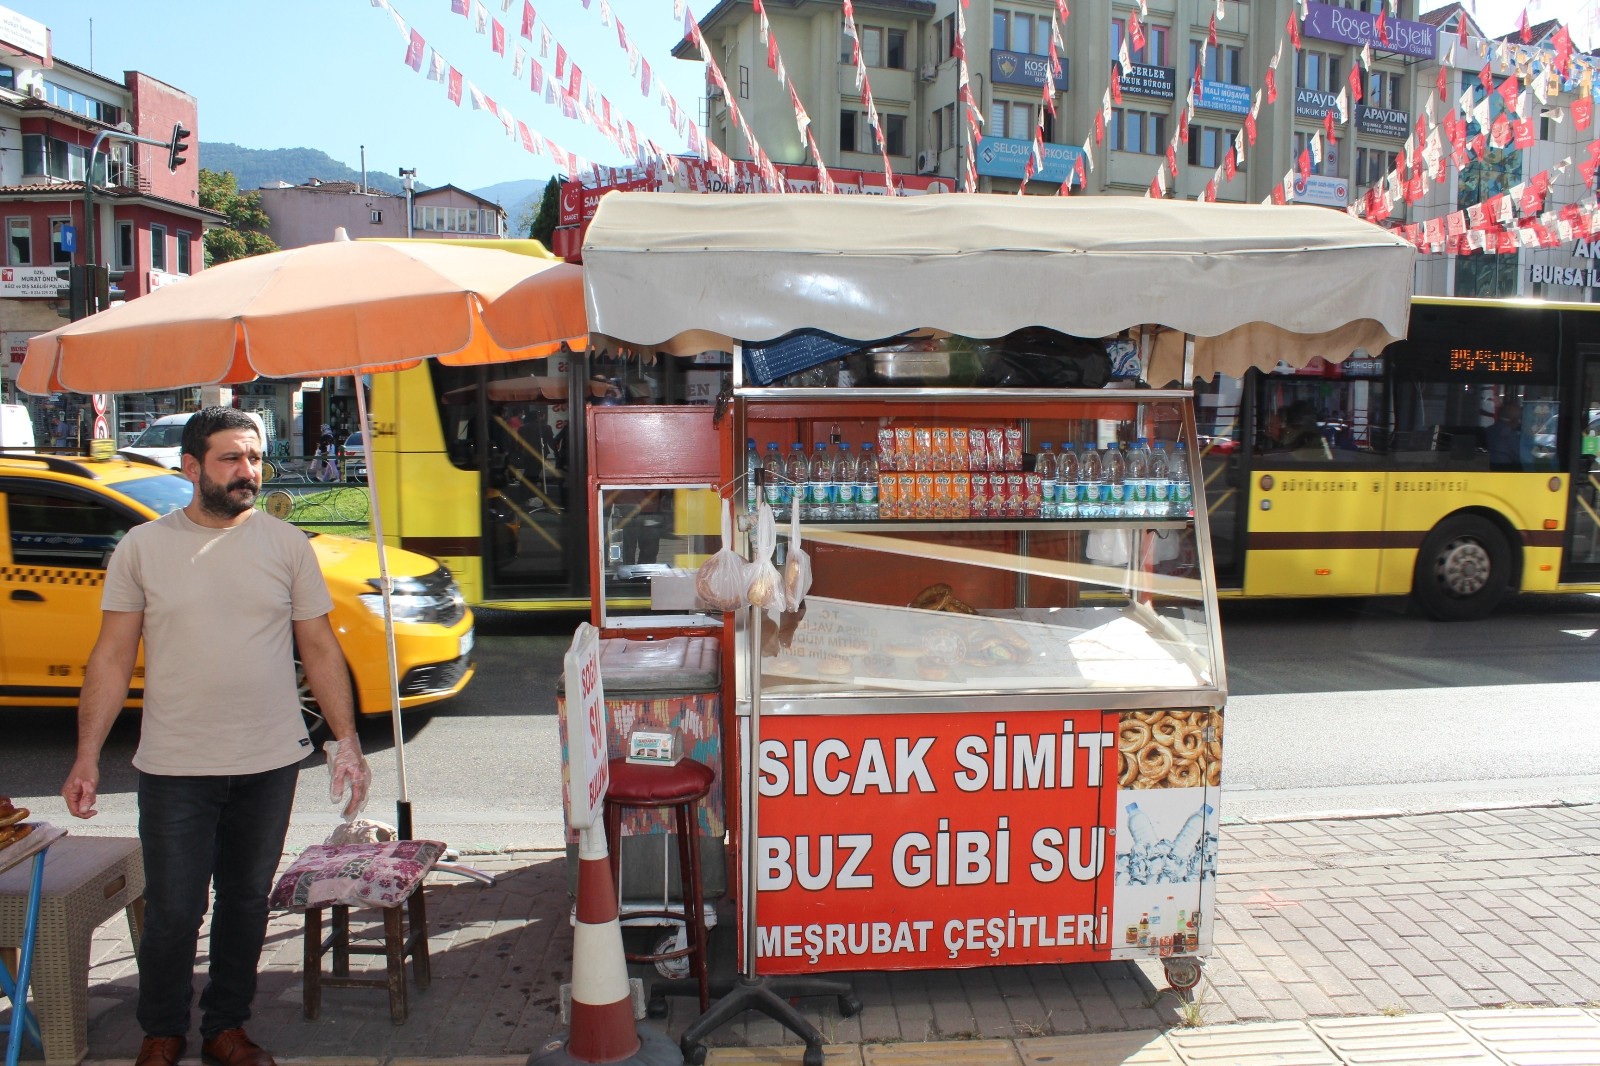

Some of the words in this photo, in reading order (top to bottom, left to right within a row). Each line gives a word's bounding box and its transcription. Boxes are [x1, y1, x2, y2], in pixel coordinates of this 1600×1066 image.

[1131, 65, 1165, 80] ÇERLER
[1296, 106, 1319, 117] HUKUK
[993, 142, 1030, 157] SELÇUK
[1531, 264, 1584, 287] BURSA
[757, 735, 938, 799] SICAK
[953, 719, 1116, 793] SİMİT
[756, 833, 875, 892] BUZ
[891, 815, 1010, 888] GİBİ
[1029, 826, 1108, 884] SU
[755, 920, 935, 965] MEŞRUBAT
[942, 906, 1109, 960] ÇEŞİTLERİ
